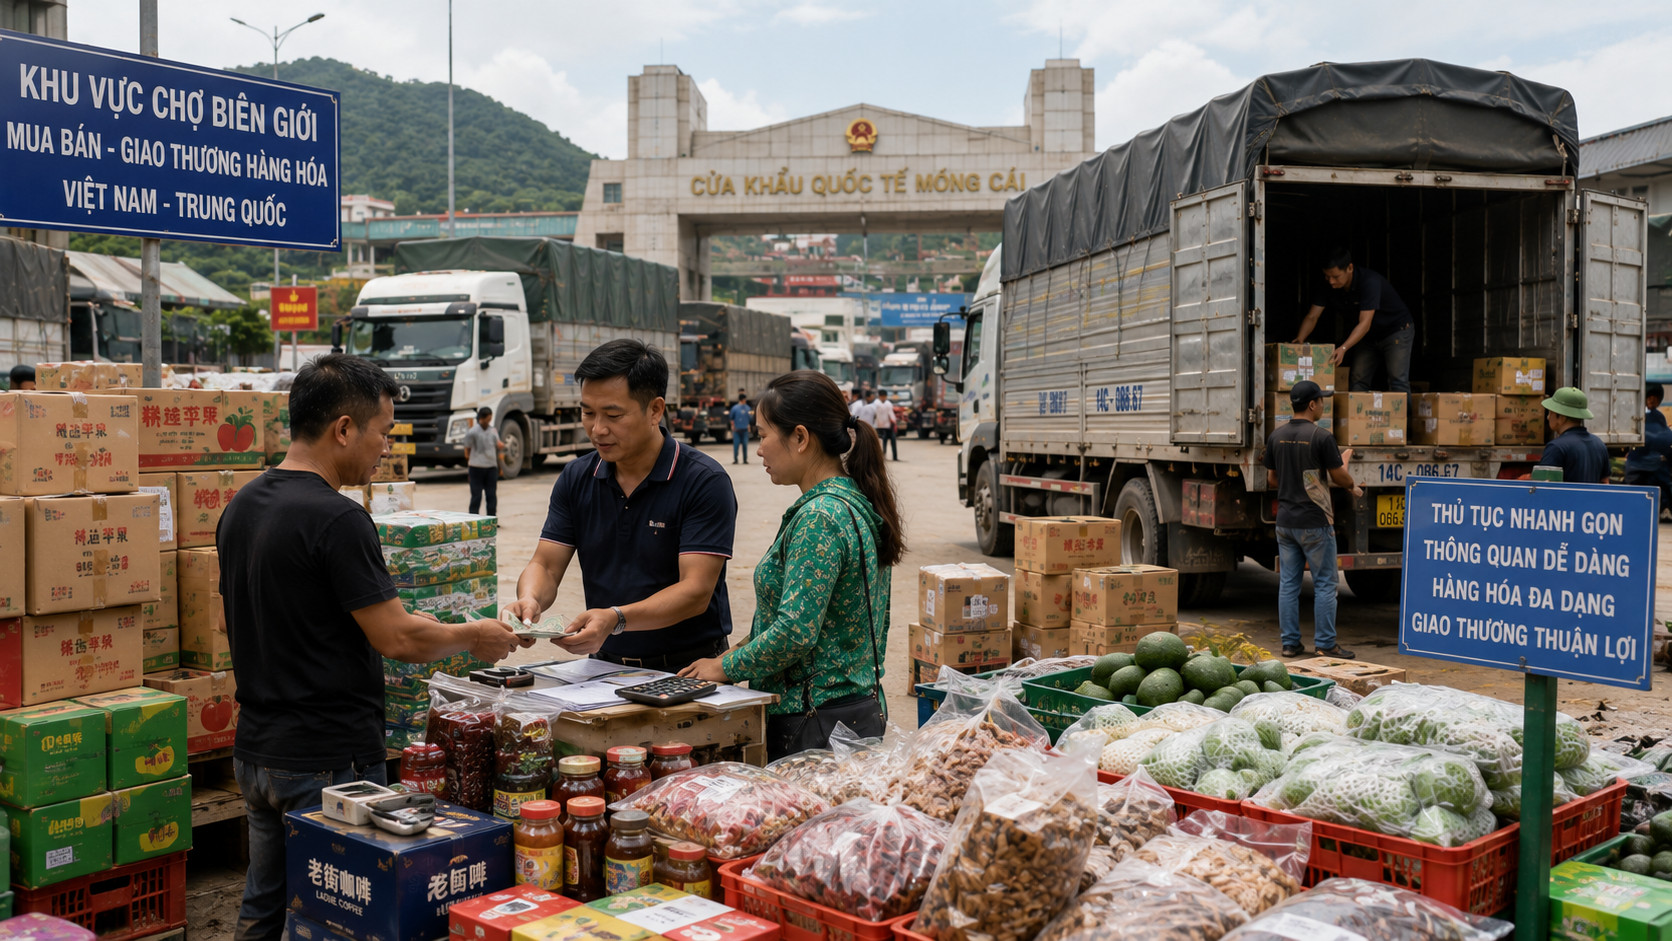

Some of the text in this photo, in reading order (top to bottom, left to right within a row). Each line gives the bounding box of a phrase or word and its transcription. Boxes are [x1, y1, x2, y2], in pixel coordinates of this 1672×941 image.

[19, 62, 317, 142] KHU VỰC CHỢ BIÊN GIỚI
[6, 121, 55, 154] MUA
[60, 123, 102, 160] BÁN
[120, 136, 165, 168] GIAO
[169, 142, 242, 177] THƯƠNG
[246, 149, 291, 183] HÀNG
[295, 156, 328, 188] HÓA
[62, 175, 108, 215] VIỆT
[114, 184, 157, 215] NAM
[175, 191, 236, 223] TRUNG
[240, 193, 287, 227] QUỐC
[690, 166, 1026, 197] CỬA KHẨU QUỐC TẾ MÓNG CÁI
[1378, 463, 1403, 483] 14C
[1431, 497, 1623, 540] THỦ TỤC NHANH GỌN
[1423, 535, 1630, 578] THÔNG QUAN DỄ DÀNG
[1432, 572, 1615, 619] HÀNG HÓA ĐA DẠNG
[1411, 611, 1637, 665] GIAO THƯƠNG THUẬN LỢI
